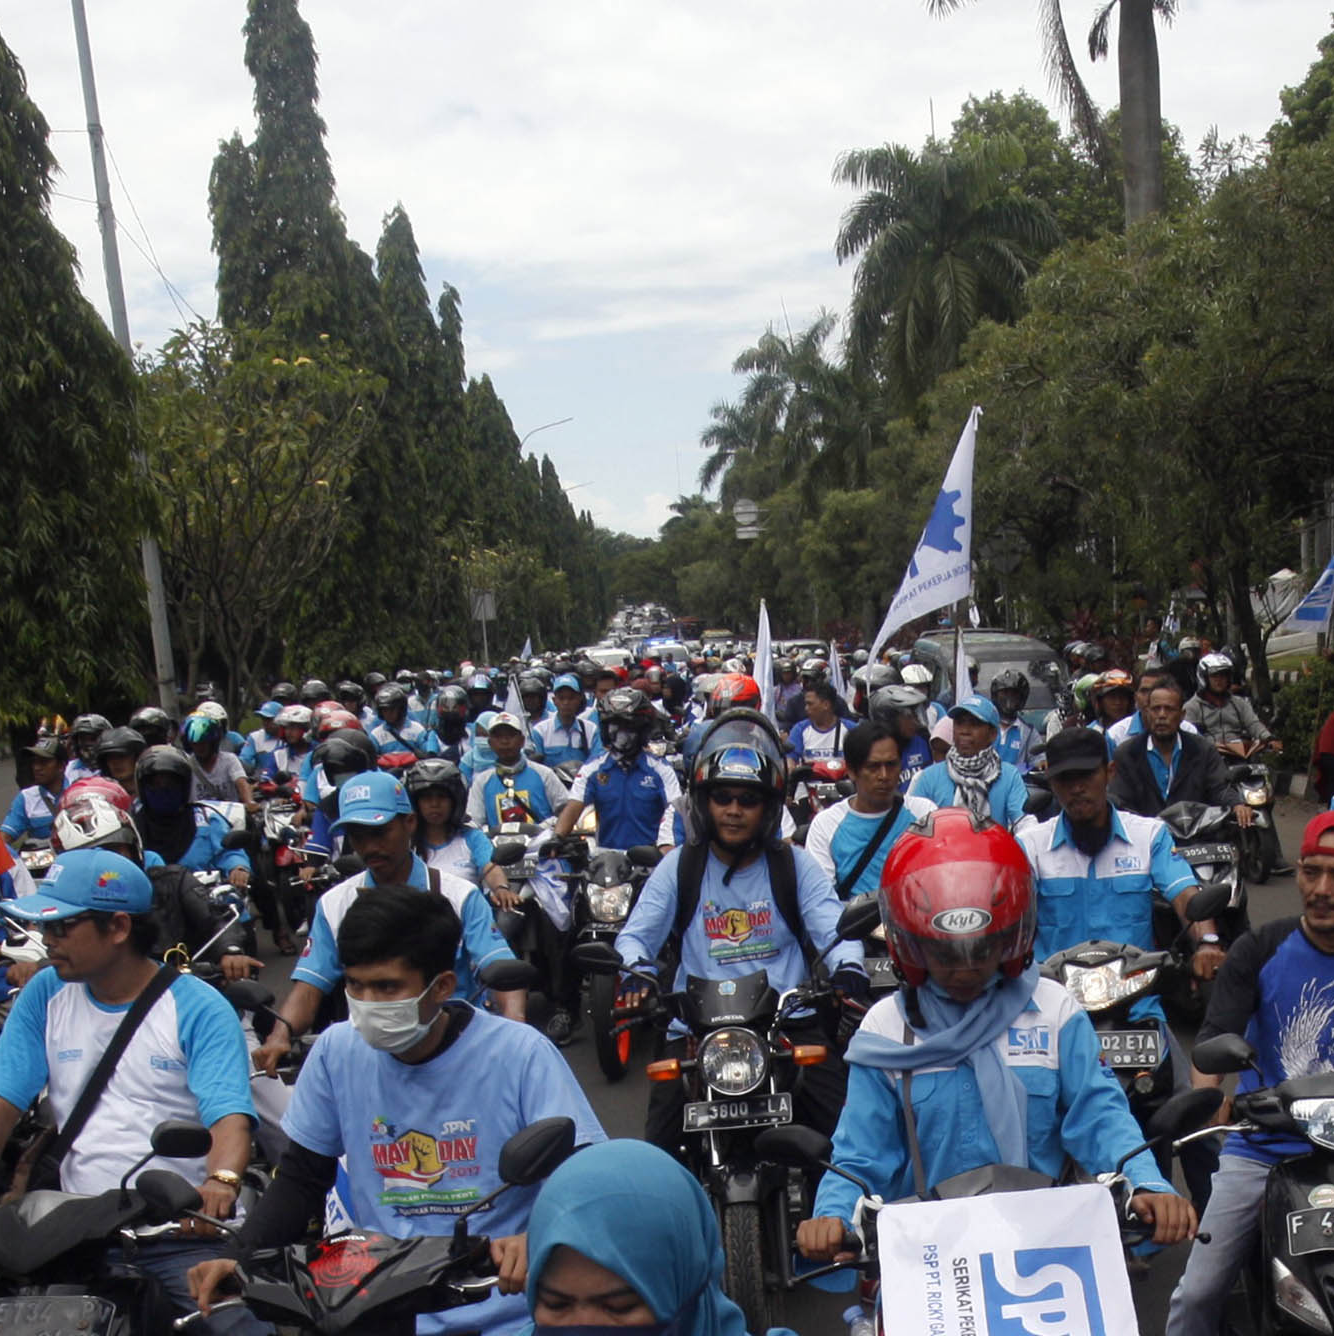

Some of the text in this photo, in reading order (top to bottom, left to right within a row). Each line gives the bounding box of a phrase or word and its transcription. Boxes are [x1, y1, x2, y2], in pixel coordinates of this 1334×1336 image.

[748, 911, 772, 928] DAY
[948, 912, 975, 928] Kyt
[1008, 1025, 1050, 1051] SPN
[1101, 1034, 1157, 1050] 02 ETA
[688, 1107, 698, 1121] F
[768, 1097, 789, 1113] LA
[440, 1119, 476, 1137] SPN
[372, 1135, 478, 1168] MAY DAY
[449, 1166, 481, 1180] 2017
[1291, 1215, 1304, 1234] F
[923, 1243, 939, 1271] PSP
[925, 1271, 940, 1290] PT.
[952, 1257, 971, 1310] SERIKAT
[927, 1290, 944, 1320] RICKY
